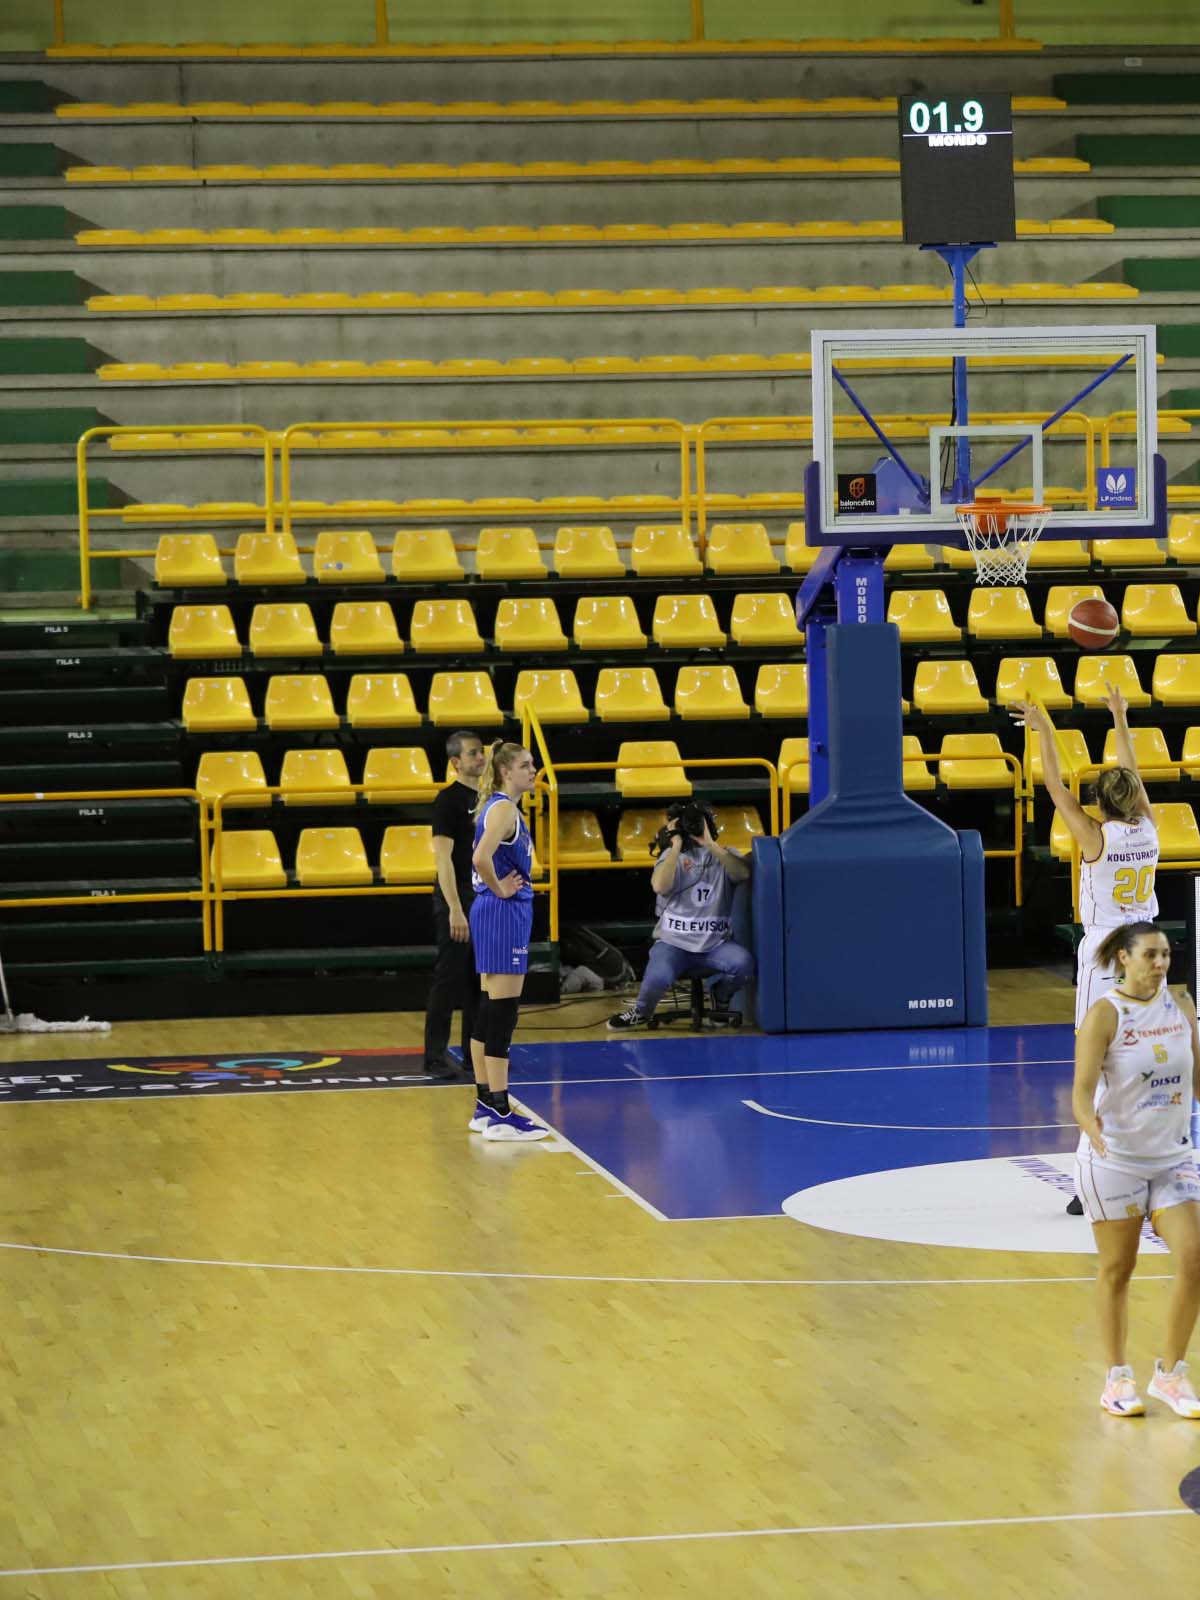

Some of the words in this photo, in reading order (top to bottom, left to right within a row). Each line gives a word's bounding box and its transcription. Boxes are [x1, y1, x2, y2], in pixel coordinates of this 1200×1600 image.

[909, 100, 984, 133] 01.9
[928, 134, 988, 147] MONDO
[855, 577, 868, 624] MONDO
[1112, 865, 1153, 905] 20
[697, 888, 710, 902] 17
[908, 998, 954, 1009] MONDO
[1152, 1044, 1168, 1064] 5
[241, 1075, 433, 1087] JUNIO
